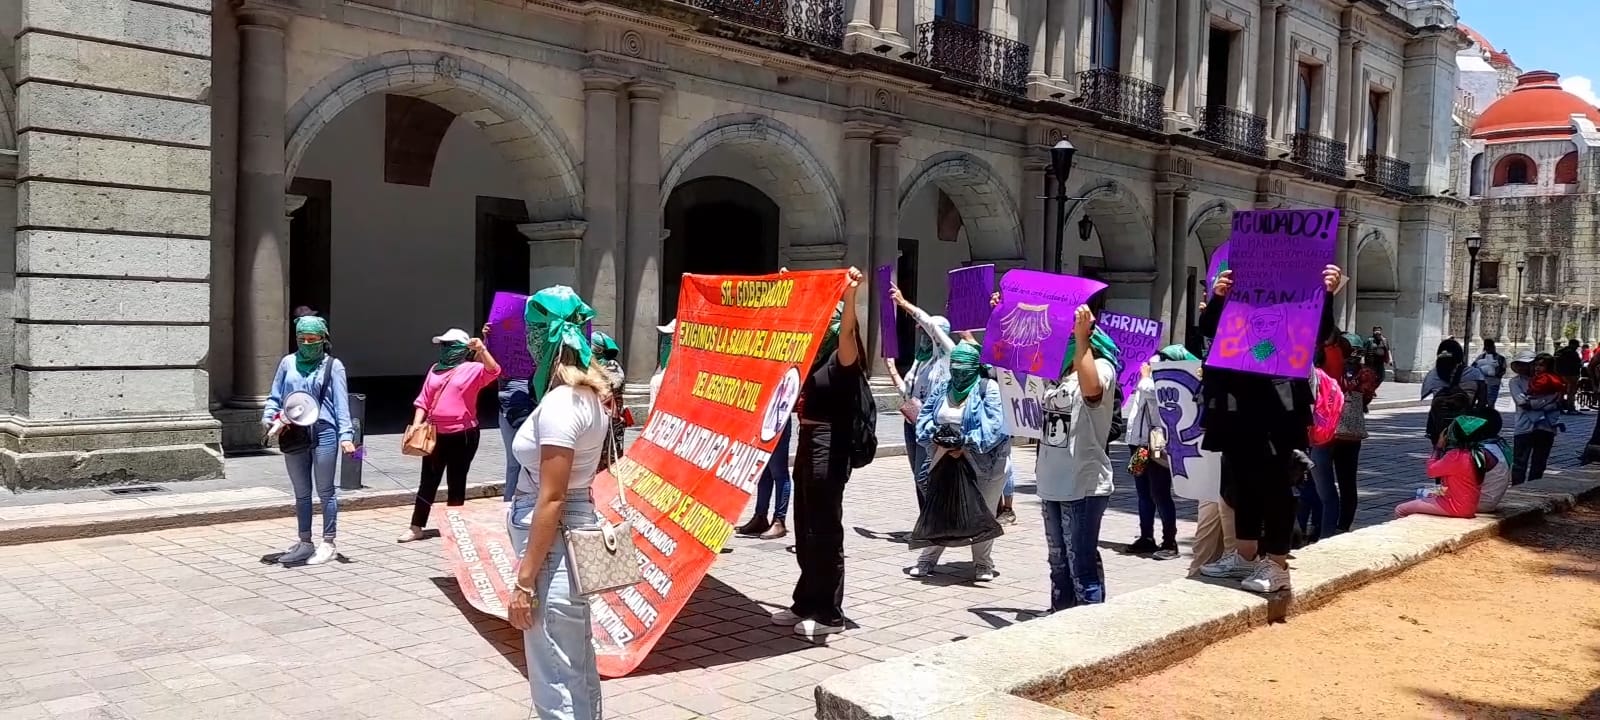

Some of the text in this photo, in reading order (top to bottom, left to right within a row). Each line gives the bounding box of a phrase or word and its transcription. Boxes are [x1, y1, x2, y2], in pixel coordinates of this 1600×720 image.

[737, 280, 794, 308] GOBERNADOR
[680, 321, 813, 363] EXIGIMOS LA SALIDA DEL DIRECTOR
[1100, 312, 1159, 337] KARINA
[691, 370, 710, 398] DEL
[703, 373, 742, 407] REGISTRO
[735, 379, 763, 413] CIVIL
[641, 409, 687, 451] ALFREDO
[673, 423, 730, 471] SANTIAGO
[680, 501, 735, 555] AUTORIDAD
